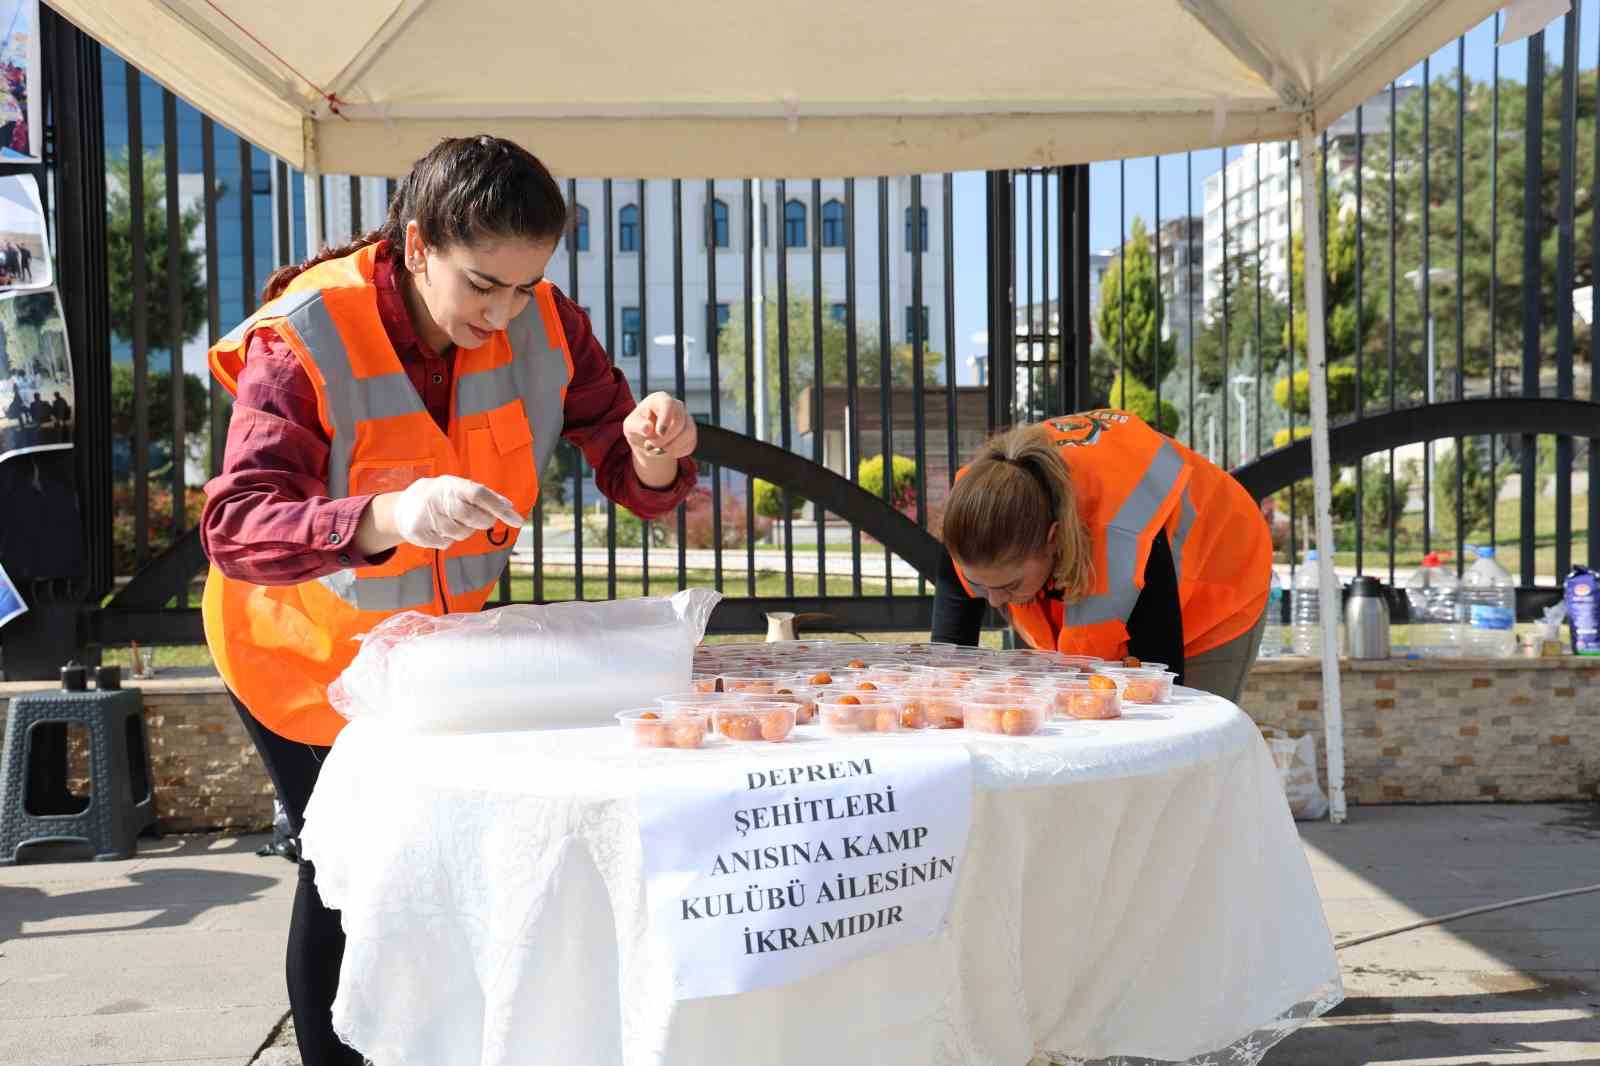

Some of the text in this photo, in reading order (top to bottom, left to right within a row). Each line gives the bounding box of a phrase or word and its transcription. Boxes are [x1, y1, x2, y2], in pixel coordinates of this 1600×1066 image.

[746, 758, 873, 791] DEPREM
[733, 785, 897, 837] ŞEHİTLERİ
[711, 826, 929, 876] ANISINA KAMP
[680, 855, 957, 921] KULÜBÜ AİLESİNİN
[743, 905, 904, 955] İKRAMIDIR
